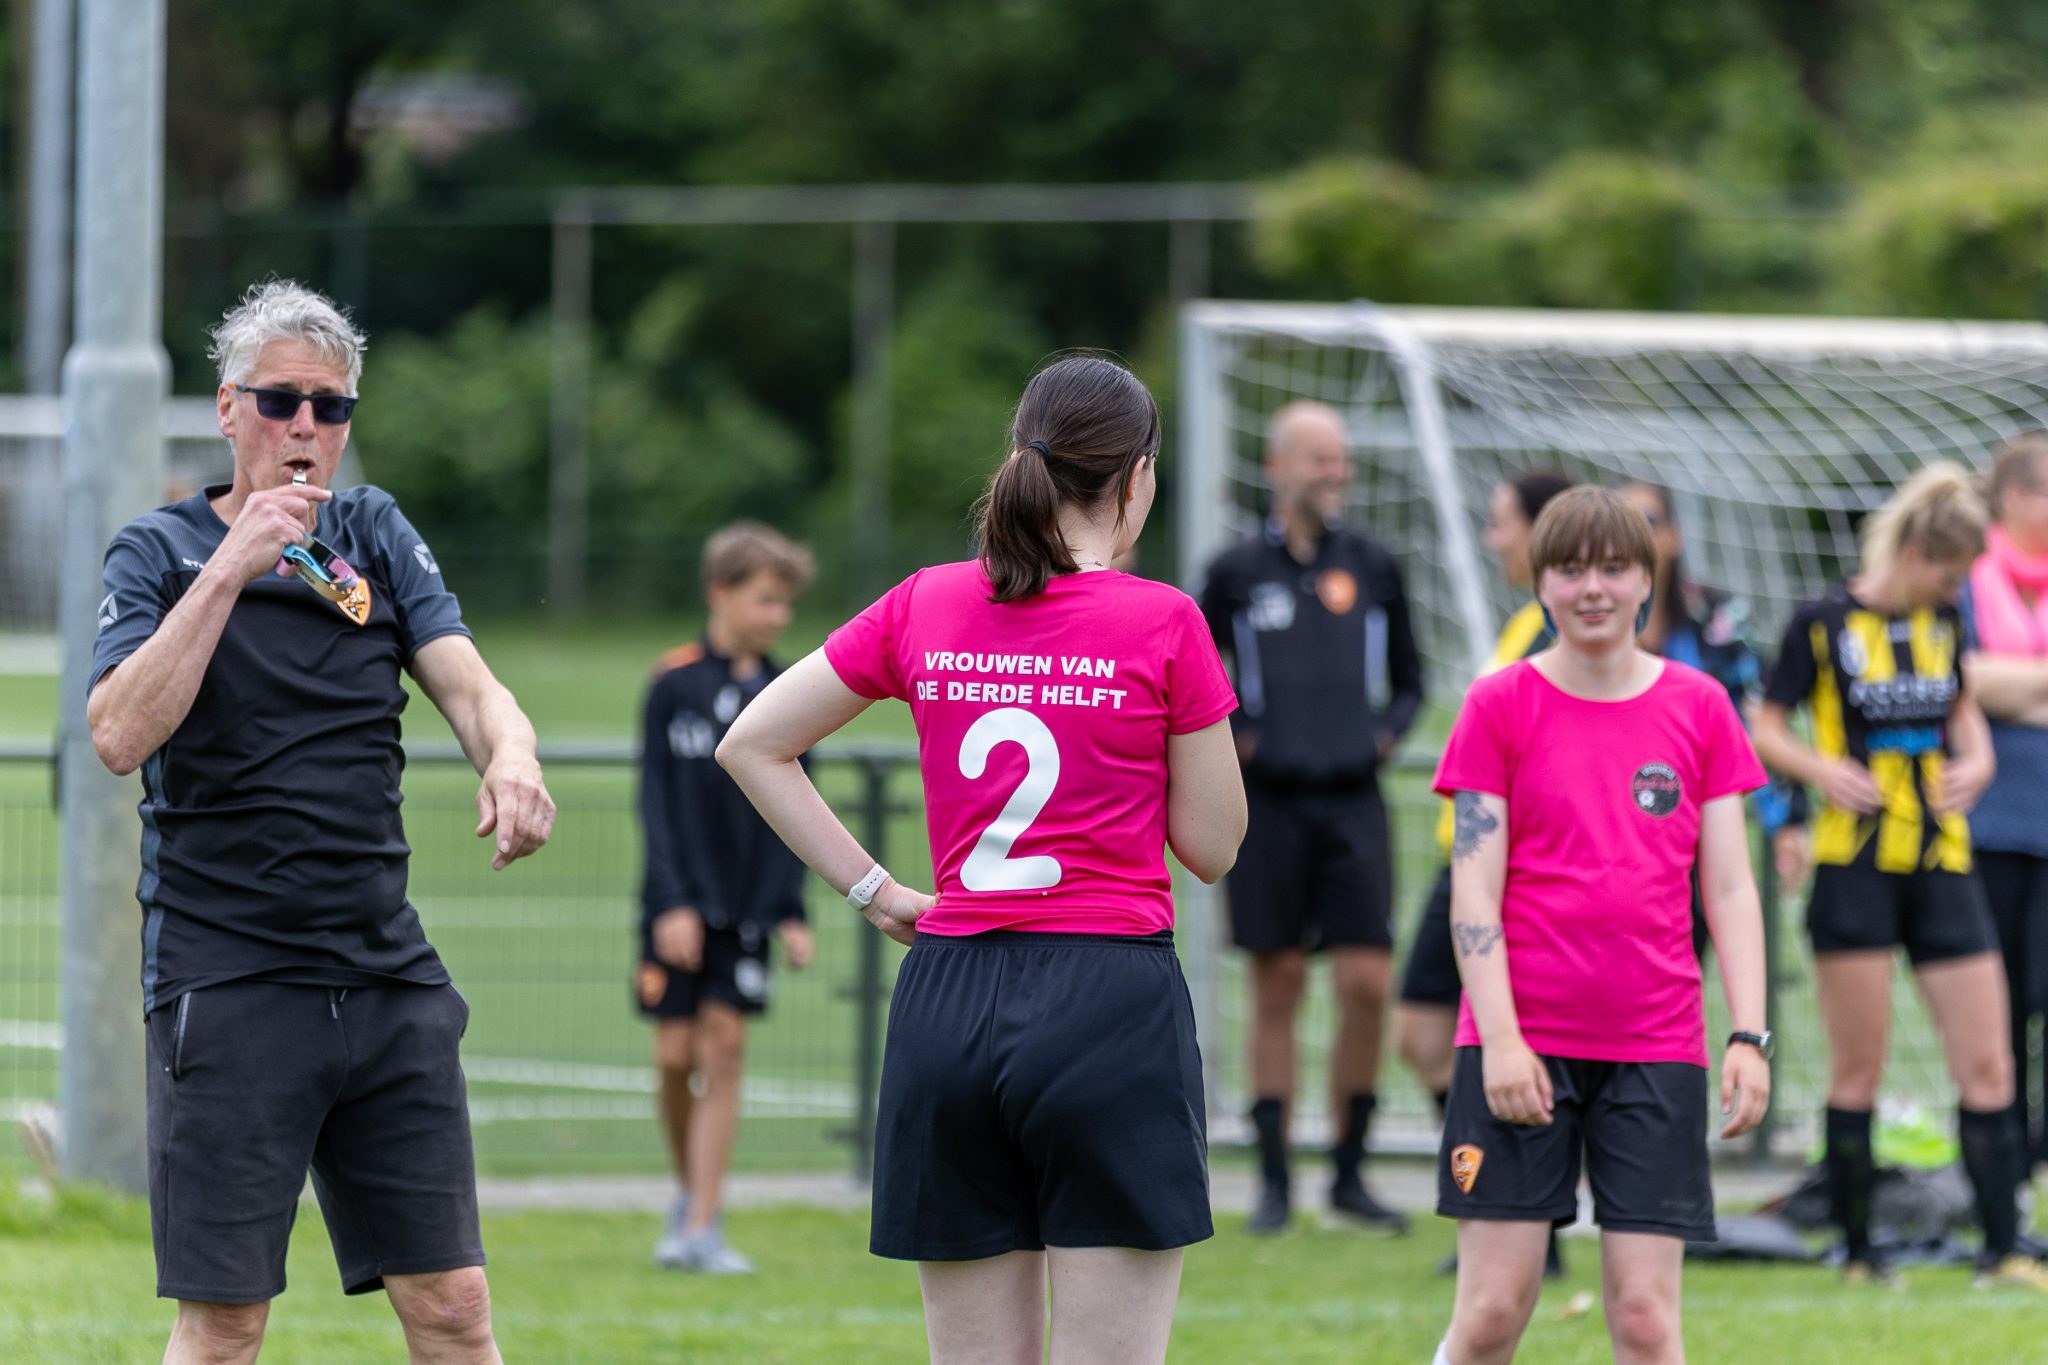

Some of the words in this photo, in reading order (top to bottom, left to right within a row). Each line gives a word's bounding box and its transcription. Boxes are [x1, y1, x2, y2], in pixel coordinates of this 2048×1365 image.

[924, 651, 1053, 675] VROUWEN
[1060, 656, 1116, 679] VAN
[916, 681, 939, 701] DE
[947, 681, 1034, 704] DERDE
[1041, 685, 1128, 709] HELFT
[958, 707, 1062, 892] 2
